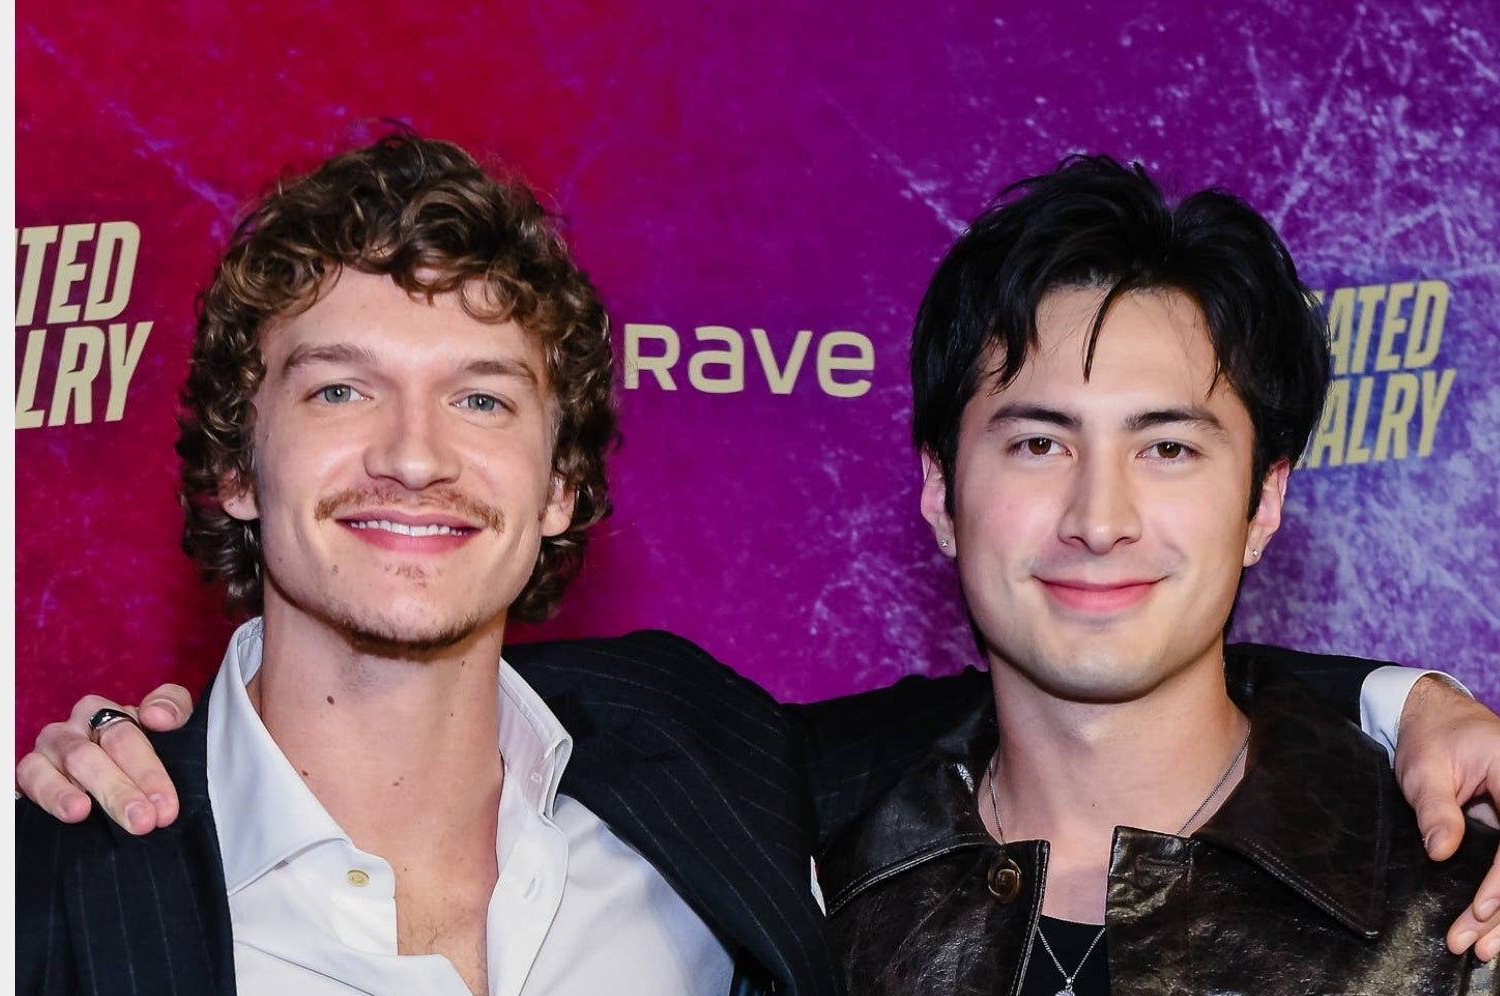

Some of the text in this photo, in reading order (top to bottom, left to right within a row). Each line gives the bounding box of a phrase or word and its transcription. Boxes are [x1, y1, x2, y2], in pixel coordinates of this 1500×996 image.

[15, 221, 141, 326] TED
[15, 321, 154, 429] LRY
[1309, 280, 1449, 375] ATED
[1296, 369, 1456, 470] ALRY
